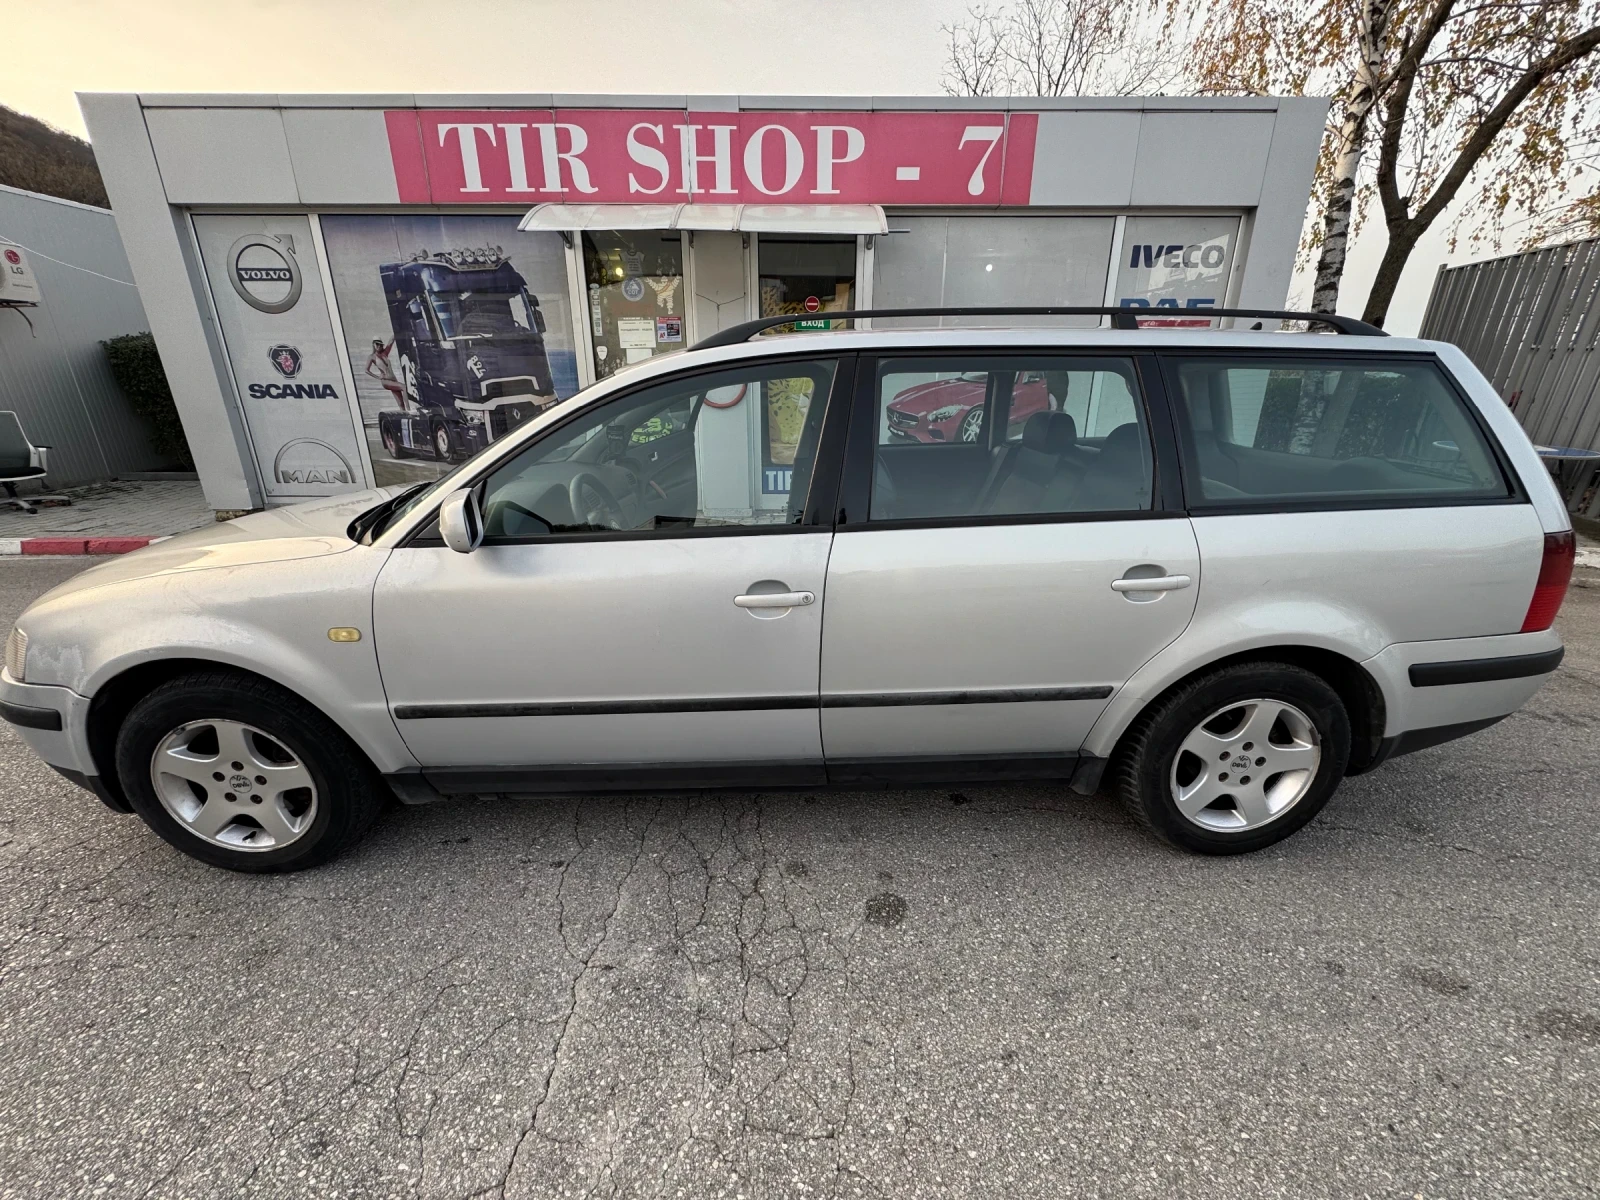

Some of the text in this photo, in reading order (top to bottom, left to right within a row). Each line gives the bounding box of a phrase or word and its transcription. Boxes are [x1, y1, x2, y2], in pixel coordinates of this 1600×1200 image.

[437, 122, 1004, 196] TIR SHOP - 7
[1129, 244, 1226, 269] IVECO
[10, 265, 24, 275] LG
[239, 270, 290, 279] VOLVO
[801, 319, 825, 328] ВХОД
[248, 383, 340, 399] SCANIA
[280, 469, 350, 484] MAN
